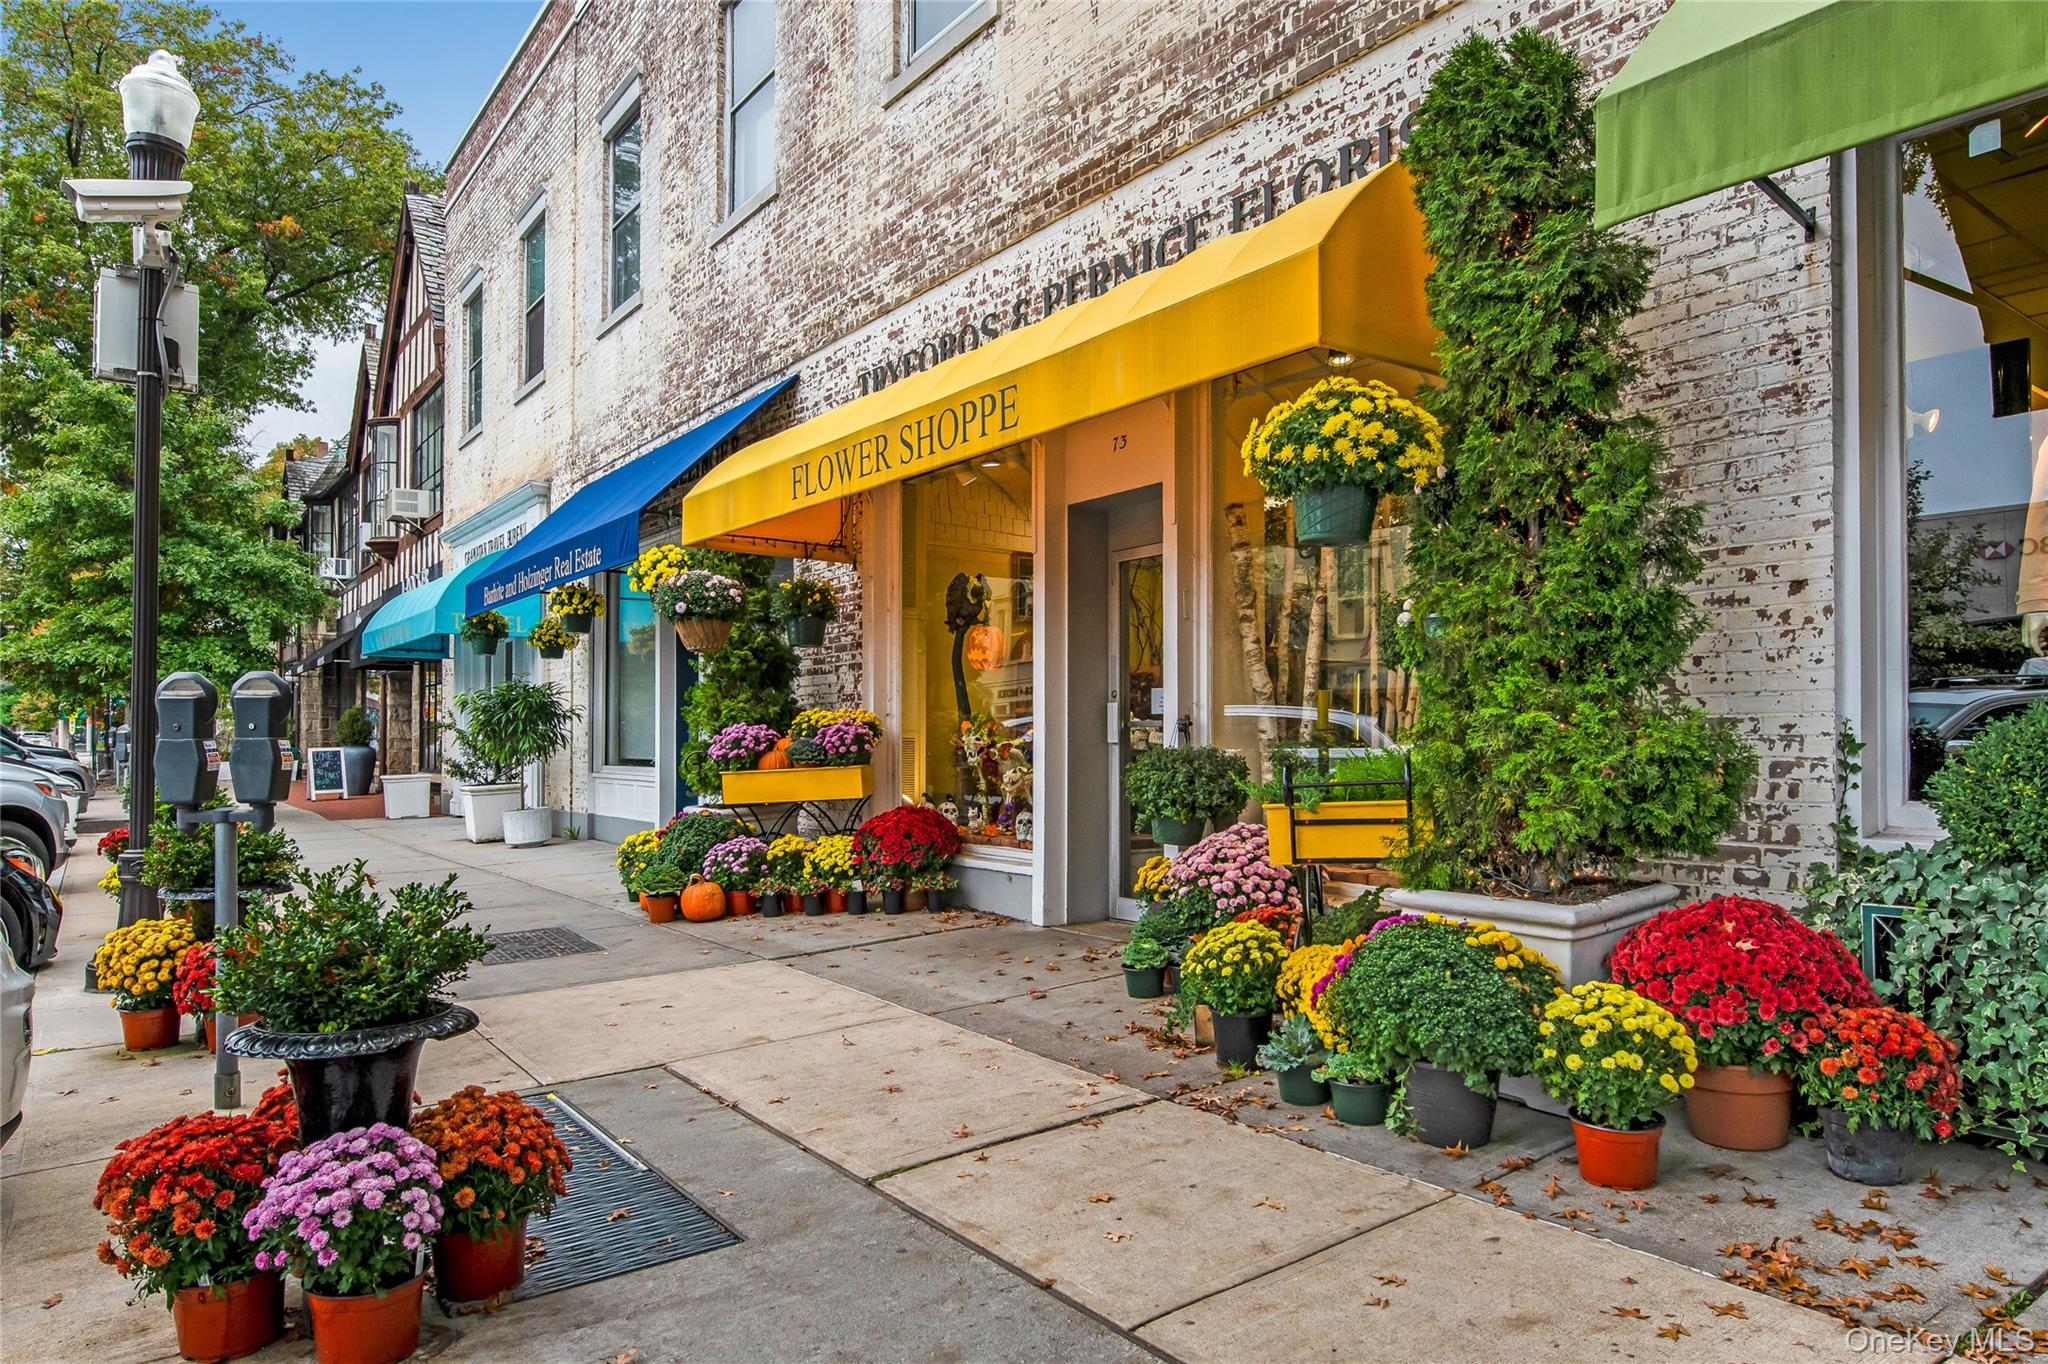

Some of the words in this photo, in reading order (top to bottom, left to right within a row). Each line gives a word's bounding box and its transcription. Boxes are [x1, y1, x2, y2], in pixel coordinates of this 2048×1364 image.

[791, 433, 892, 501] FLOWER
[899, 384, 1020, 465] SHOPPE
[1112, 435, 1127, 452] 73
[505, 574, 517, 598] and
[518, 565, 552, 593] Holzinger
[554, 550, 573, 579] Real
[574, 545, 602, 573] Estate
